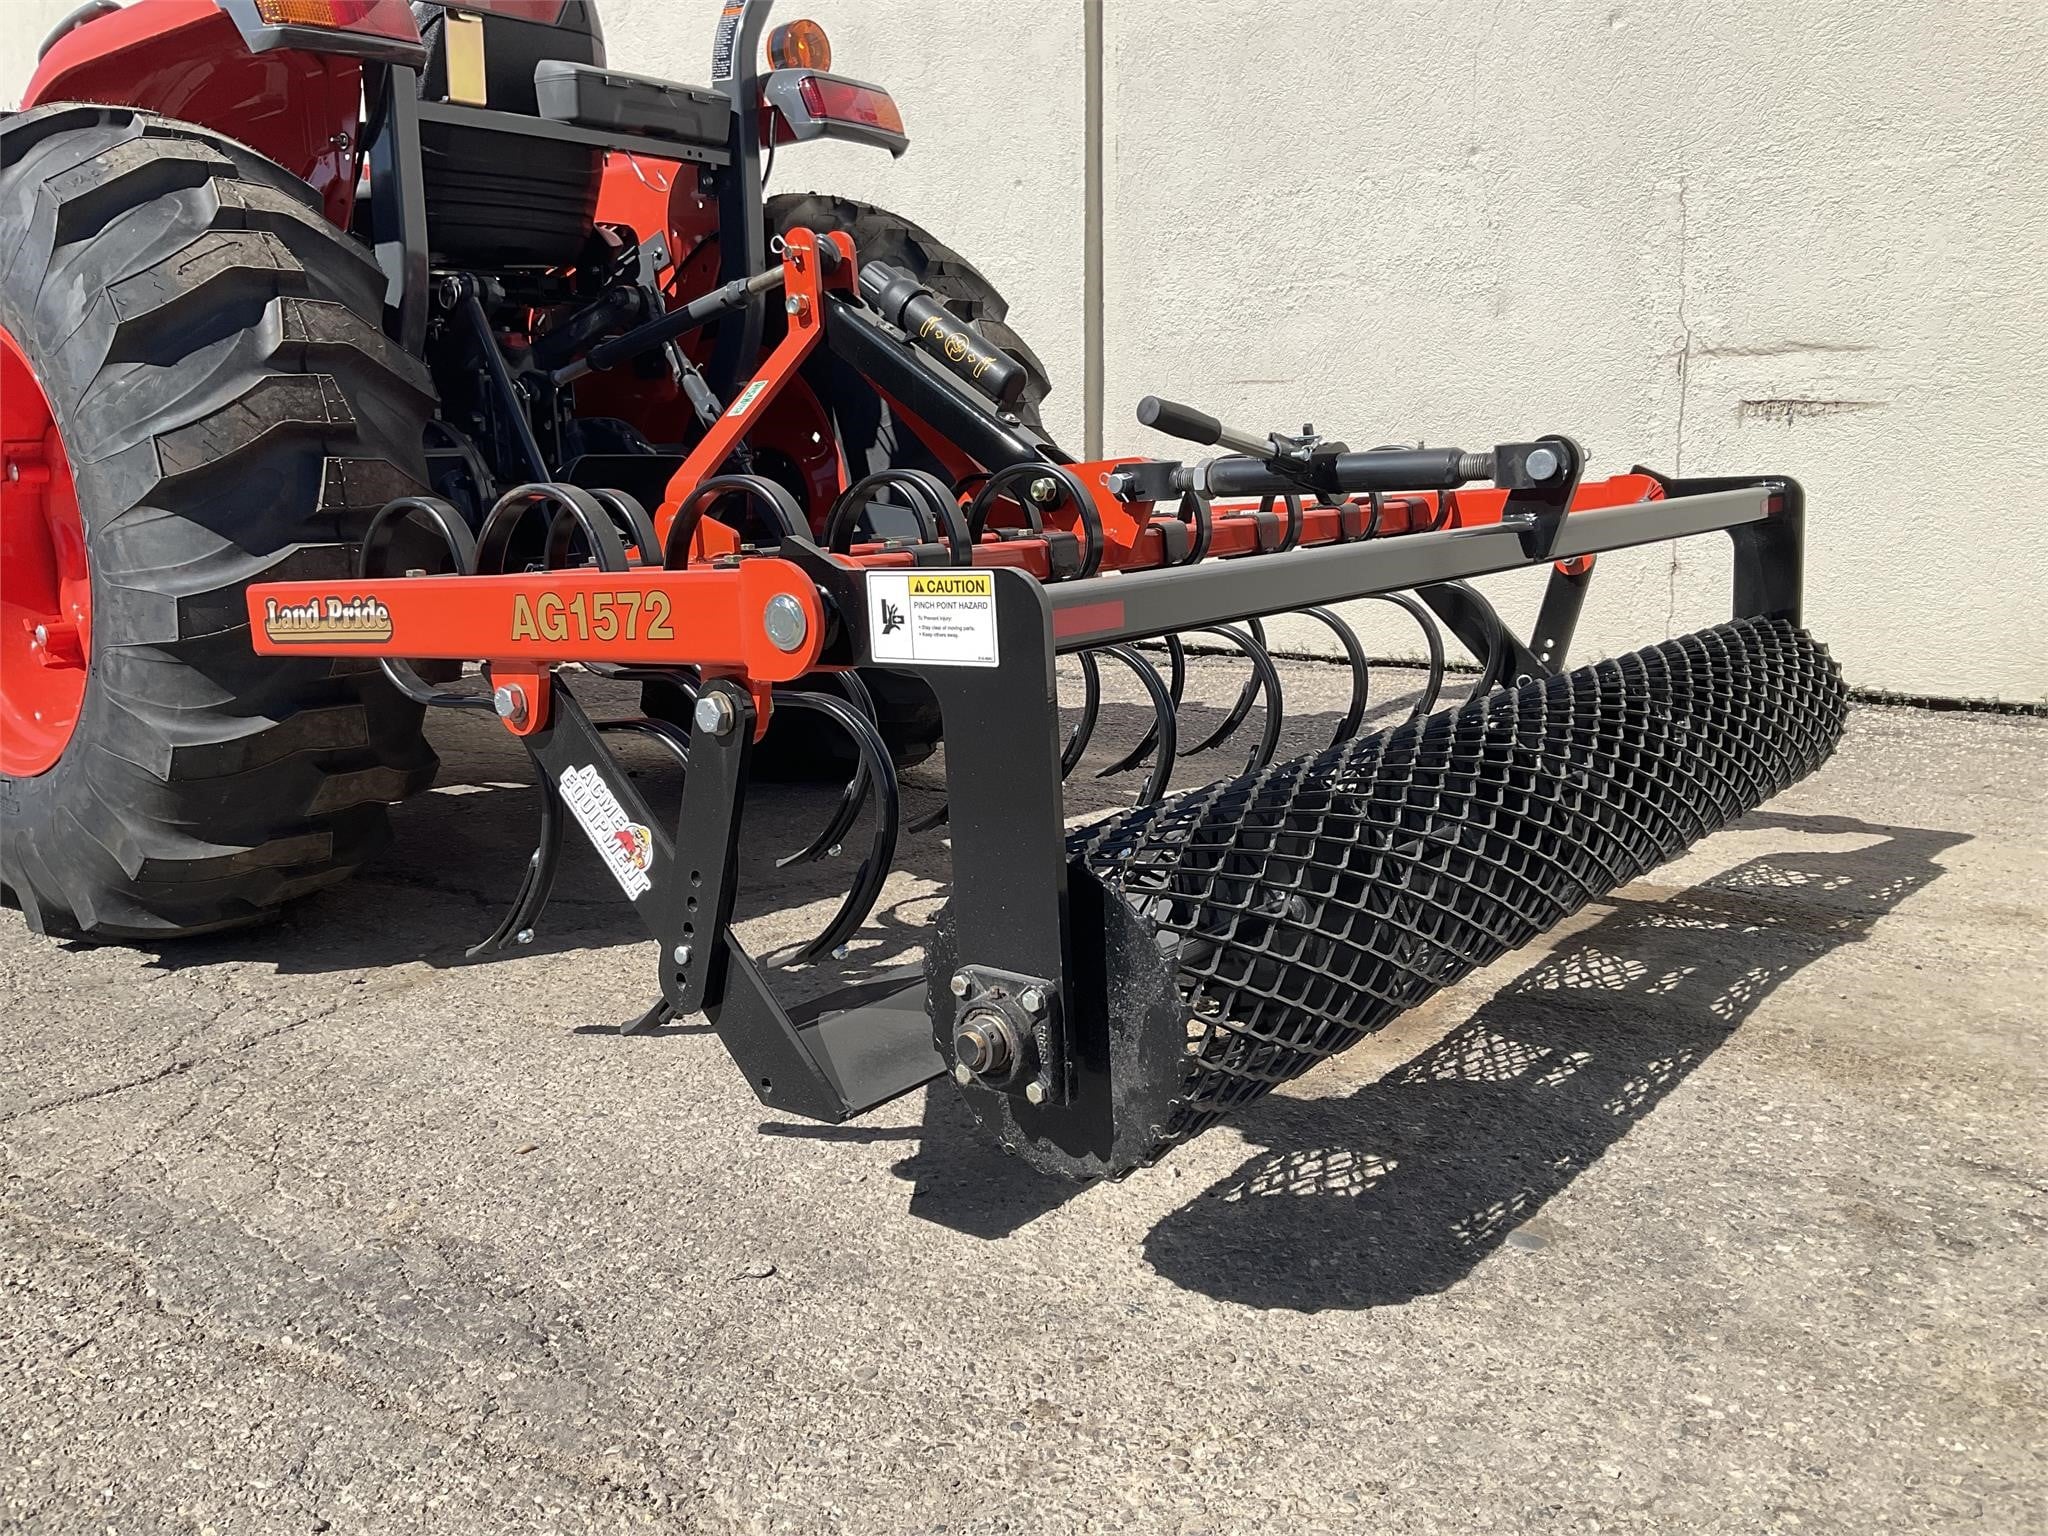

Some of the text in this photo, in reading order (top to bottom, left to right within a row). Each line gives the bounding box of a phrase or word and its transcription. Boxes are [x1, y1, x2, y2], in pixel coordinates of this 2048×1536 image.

[913, 601, 988, 610] PINCH POINT HAZARD
[927, 580, 985, 593] CAUTION
[265, 596, 389, 630] Land Pride
[511, 590, 675, 641] AG1572
[580, 767, 627, 831] ACME
[562, 769, 649, 891] EQUIPMENT
